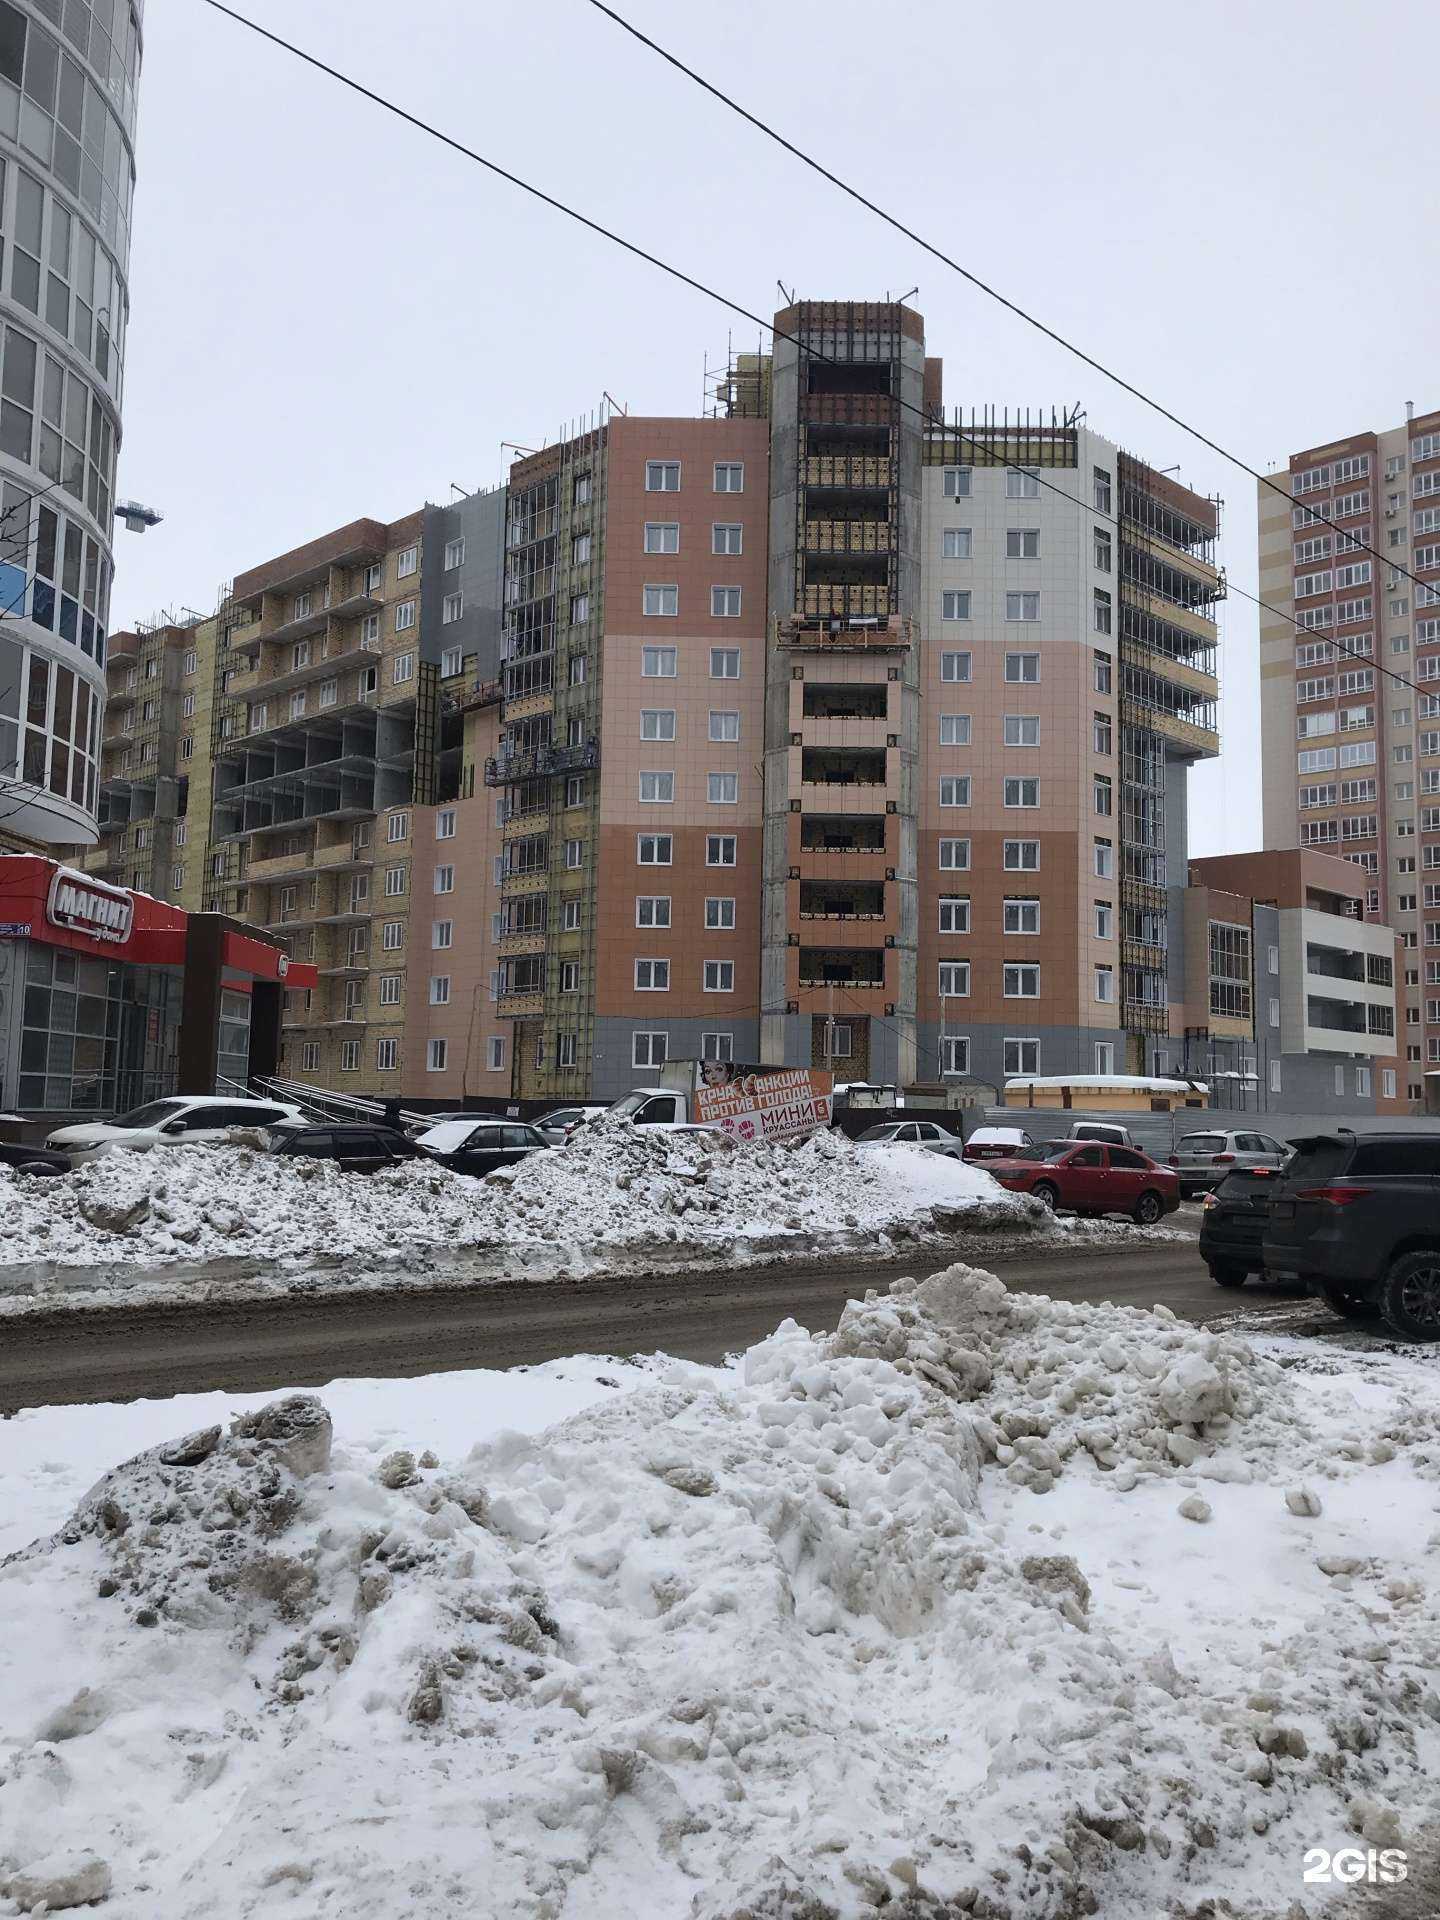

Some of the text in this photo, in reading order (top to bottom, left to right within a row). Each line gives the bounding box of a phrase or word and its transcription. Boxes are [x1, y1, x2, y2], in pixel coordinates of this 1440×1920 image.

[57, 884, 130, 930] МАГНИТ
[20, 925, 30, 934] 10
[701, 1085, 814, 1121] ПРОТИВ ГОЛОДА!
[760, 1102, 814, 1127] МИНИ
[762, 1117, 816, 1135] КРУАССАНЫ
